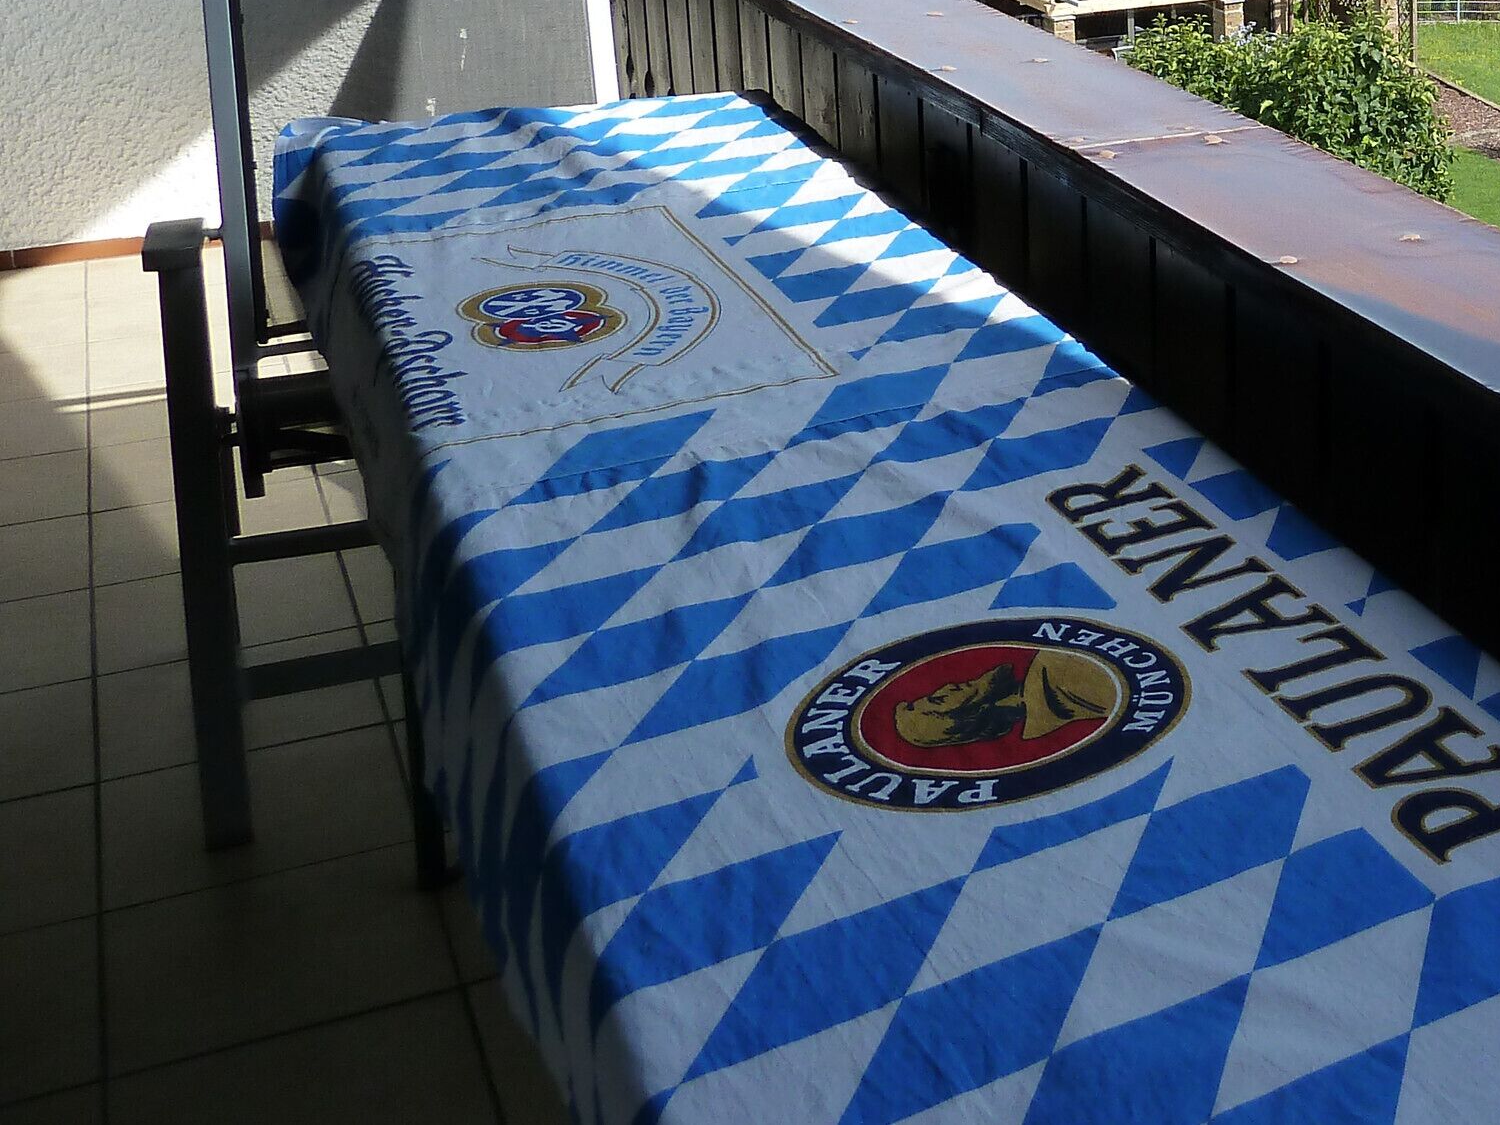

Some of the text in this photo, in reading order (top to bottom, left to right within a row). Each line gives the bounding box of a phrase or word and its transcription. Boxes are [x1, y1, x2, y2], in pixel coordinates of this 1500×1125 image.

[557, 253, 675, 284] Himmel
[633, 306, 709, 356] Bayern
[802, 658, 1000, 805] PAULANER
[1033, 621, 1174, 733] MÜNCHEN
